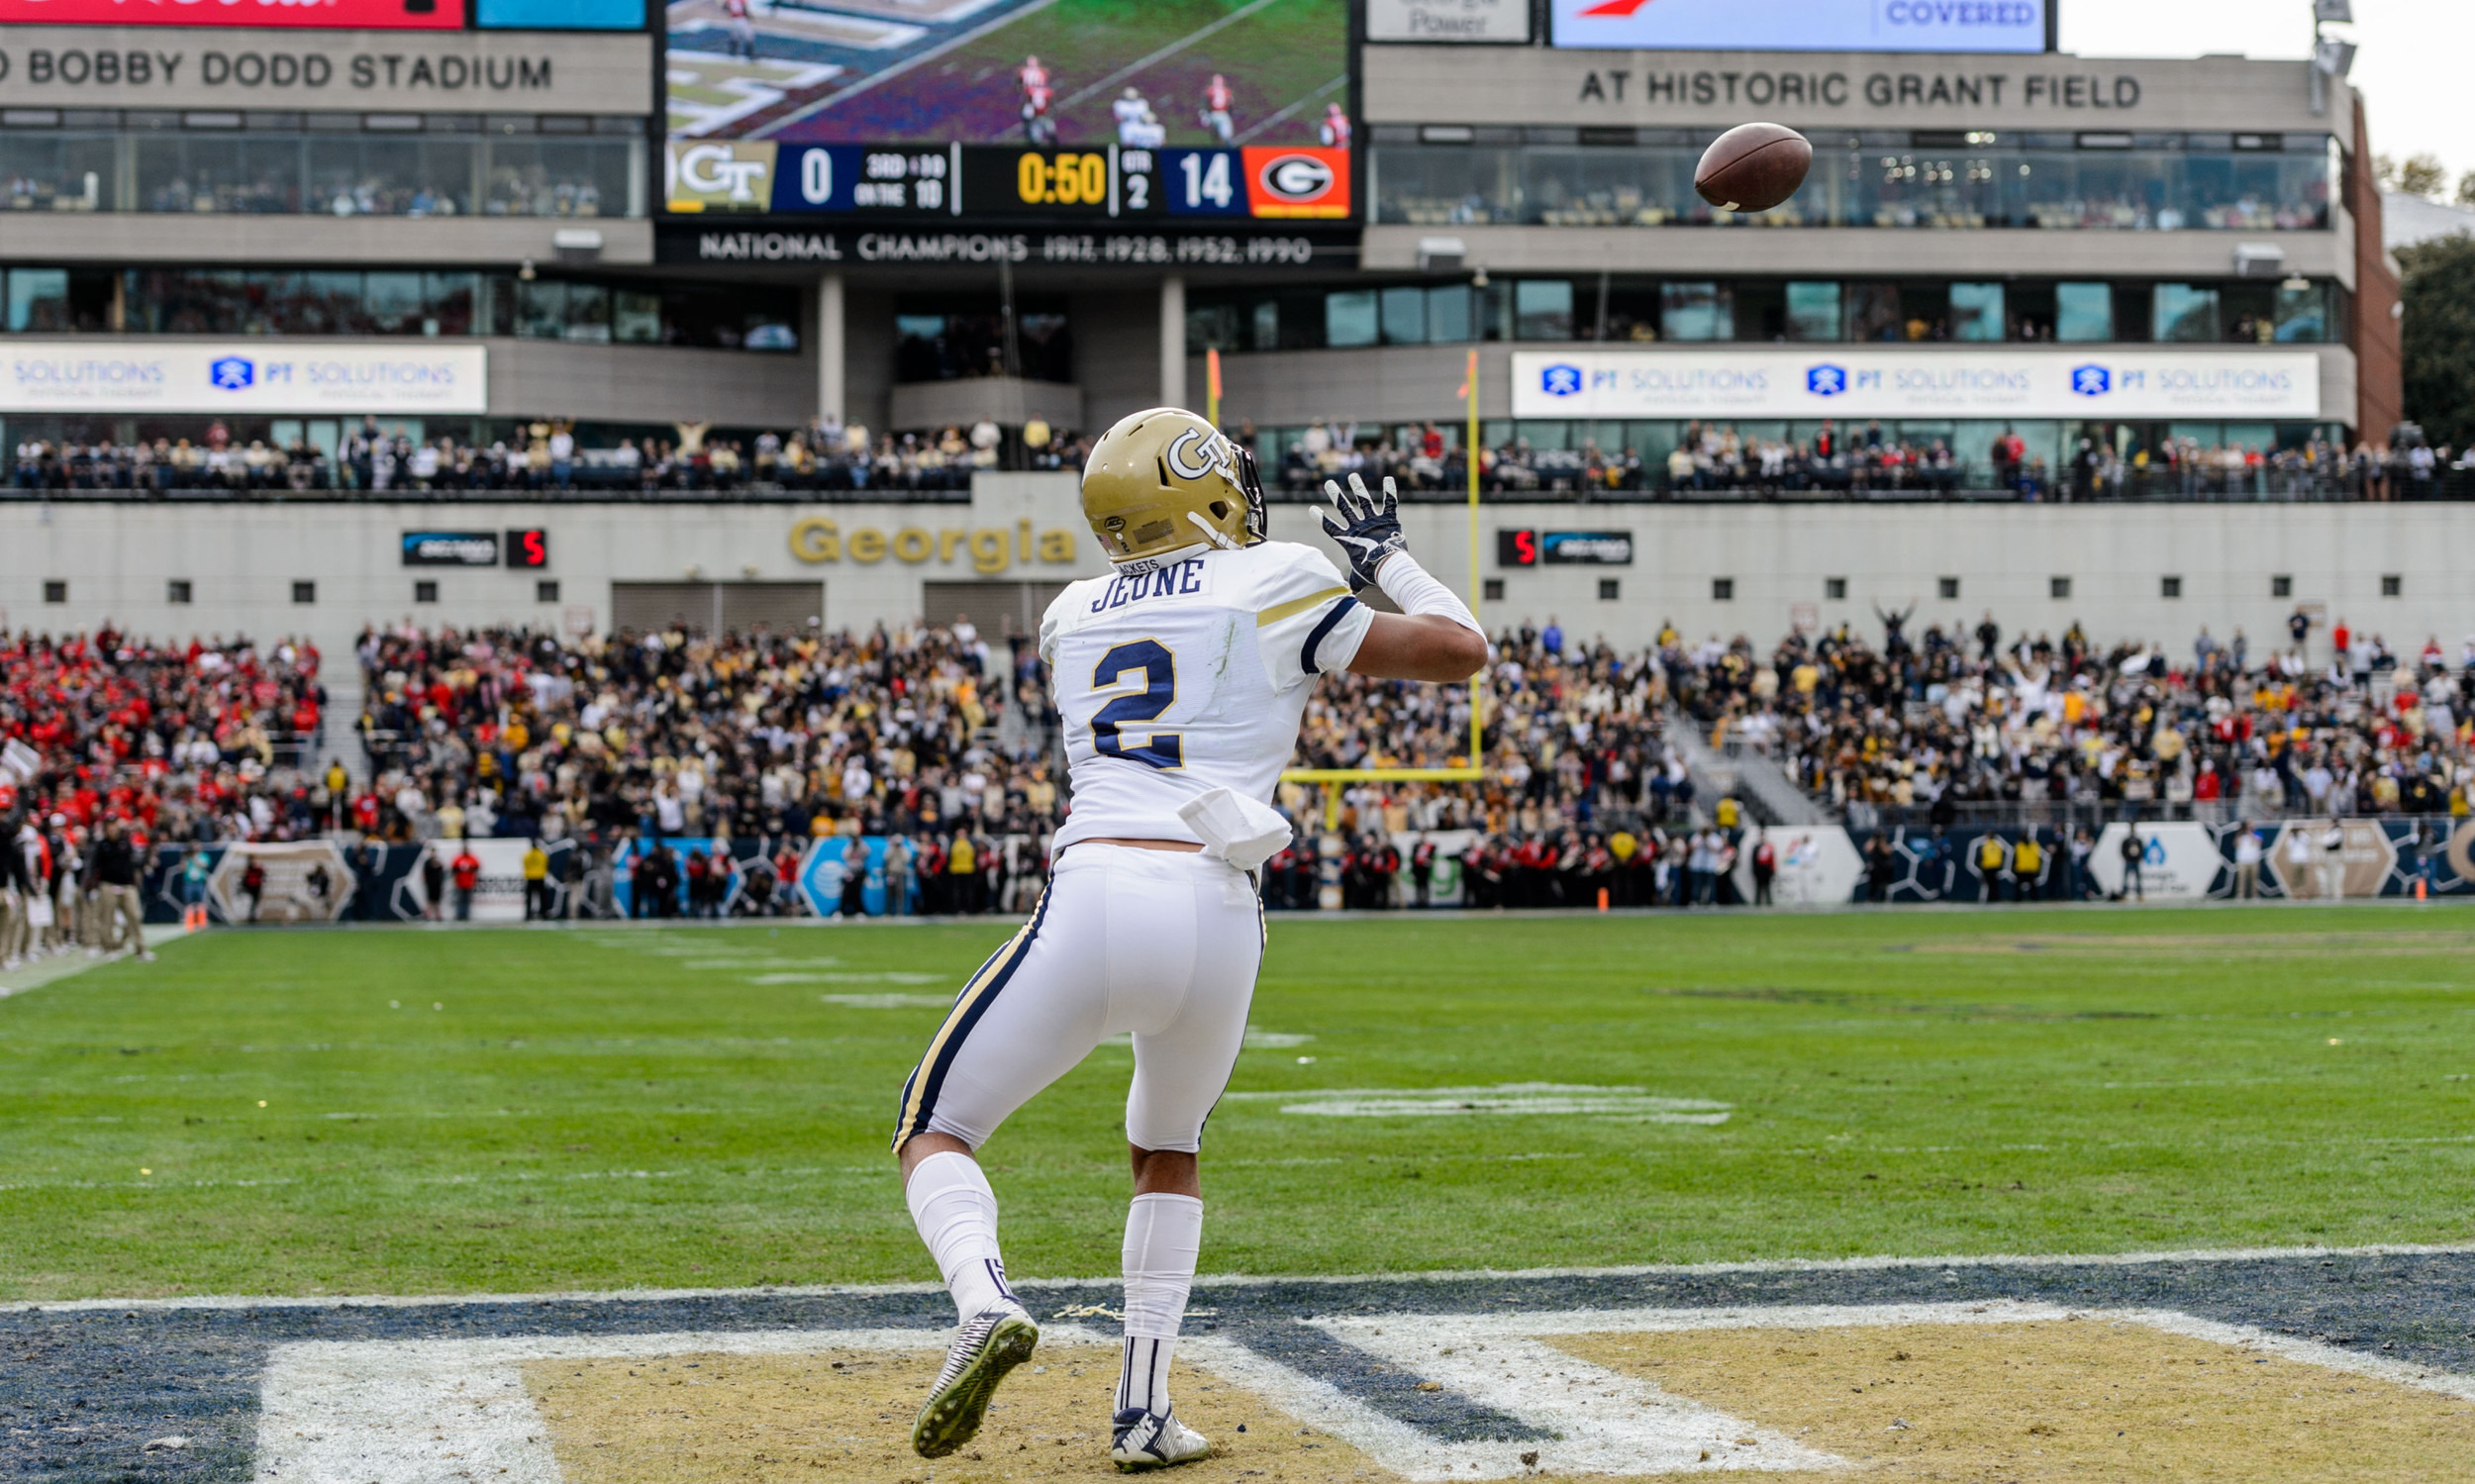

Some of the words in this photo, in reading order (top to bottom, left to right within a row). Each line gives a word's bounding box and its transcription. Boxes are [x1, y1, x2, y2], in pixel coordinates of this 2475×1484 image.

[1409, 7, 1488, 34] Power
[1886, 0, 2035, 26] COVERED
[28, 49, 183, 85] BOBBY
[202, 51, 333, 87] DODD
[349, 53, 552, 90] STADIUM
[1579, 70, 1631, 102] AT
[1647, 71, 1848, 106] HISTORIC
[1864, 72, 2008, 107] GRANT
[2025, 74, 2141, 109] FIELD
[801, 148, 833, 205] 0
[1018, 151, 1106, 205] 0:50
[1127, 173, 1149, 209] 2
[1180, 152, 1234, 209] 14
[915, 179, 943, 209] 10
[699, 232, 843, 260] NATIONAL
[857, 233, 1029, 262] CHAMPIONS
[1105, 235, 1173, 264] 1928,
[1177, 236, 1244, 264] 1952,
[1247, 236, 1313, 264] 1990
[14, 359, 166, 383] SOLUTIONS
[264, 360, 295, 383] PT
[307, 360, 456, 384] SOLUTIONS
[1592, 368, 1620, 390] PT
[1631, 368, 1770, 391] SOLUTIONS
[1855, 368, 1884, 391] PT
[1895, 368, 2031, 391] SOLUTIONS
[2120, 368, 2147, 391] PT
[2157, 368, 2293, 391] SOLUTIONS
[788, 517, 1077, 574] Georgia
[1118, 558, 1160, 575] ACKETS
[1091, 558, 1205, 614] JEUNE
[1089, 637, 1186, 771] 2
[1121, 1412, 1158, 1455] NIKE
